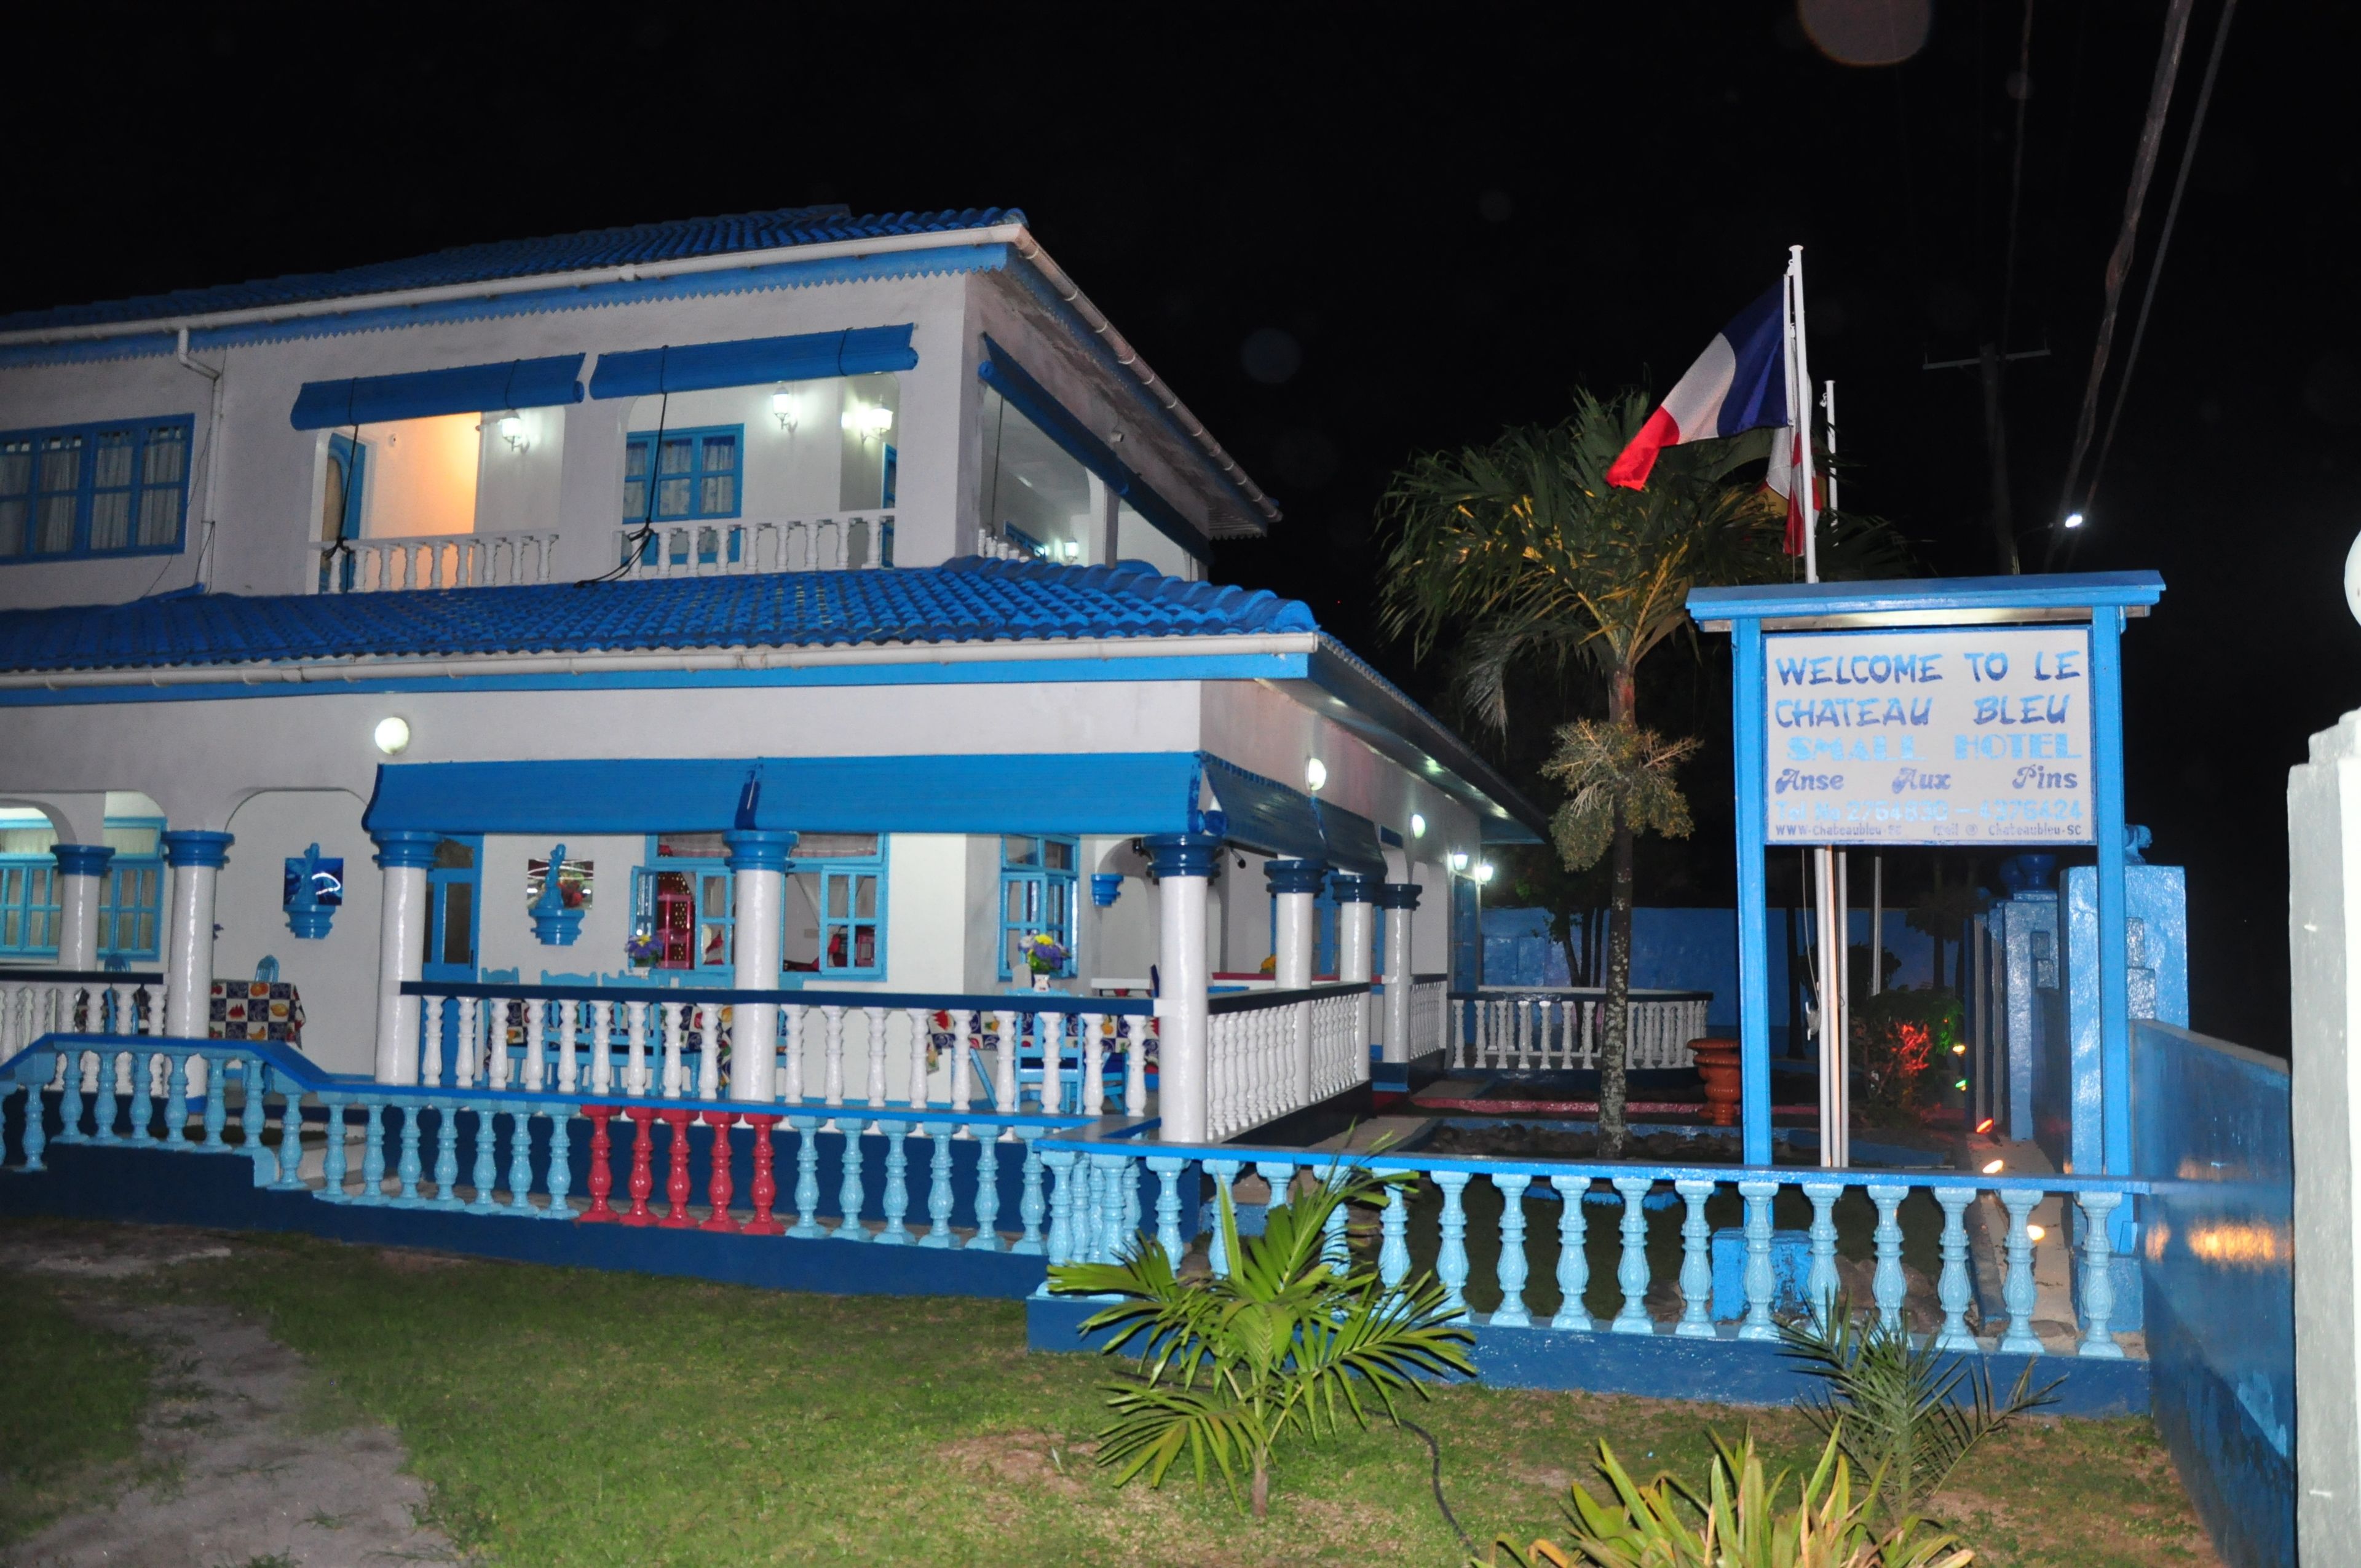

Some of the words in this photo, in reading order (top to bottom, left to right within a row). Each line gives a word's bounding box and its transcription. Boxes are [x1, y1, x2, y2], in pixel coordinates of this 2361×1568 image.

[1775, 653, 1943, 686] WELCOME
[1964, 652, 2009, 681] TO
[2035, 650, 2081, 682] LE
[1775, 697, 1933, 728] CHATEAU
[1974, 694, 2070, 726] BLEU
[1787, 734, 1927, 761] SMALL
[1953, 732, 2082, 760] HOTEL
[1775, 769, 1845, 794] Anse
[1891, 767, 1951, 794] Aux
[2012, 766, 2078, 790] Pins
[1776, 801, 1806, 821] Tel
[1814, 802, 1841, 821] No
